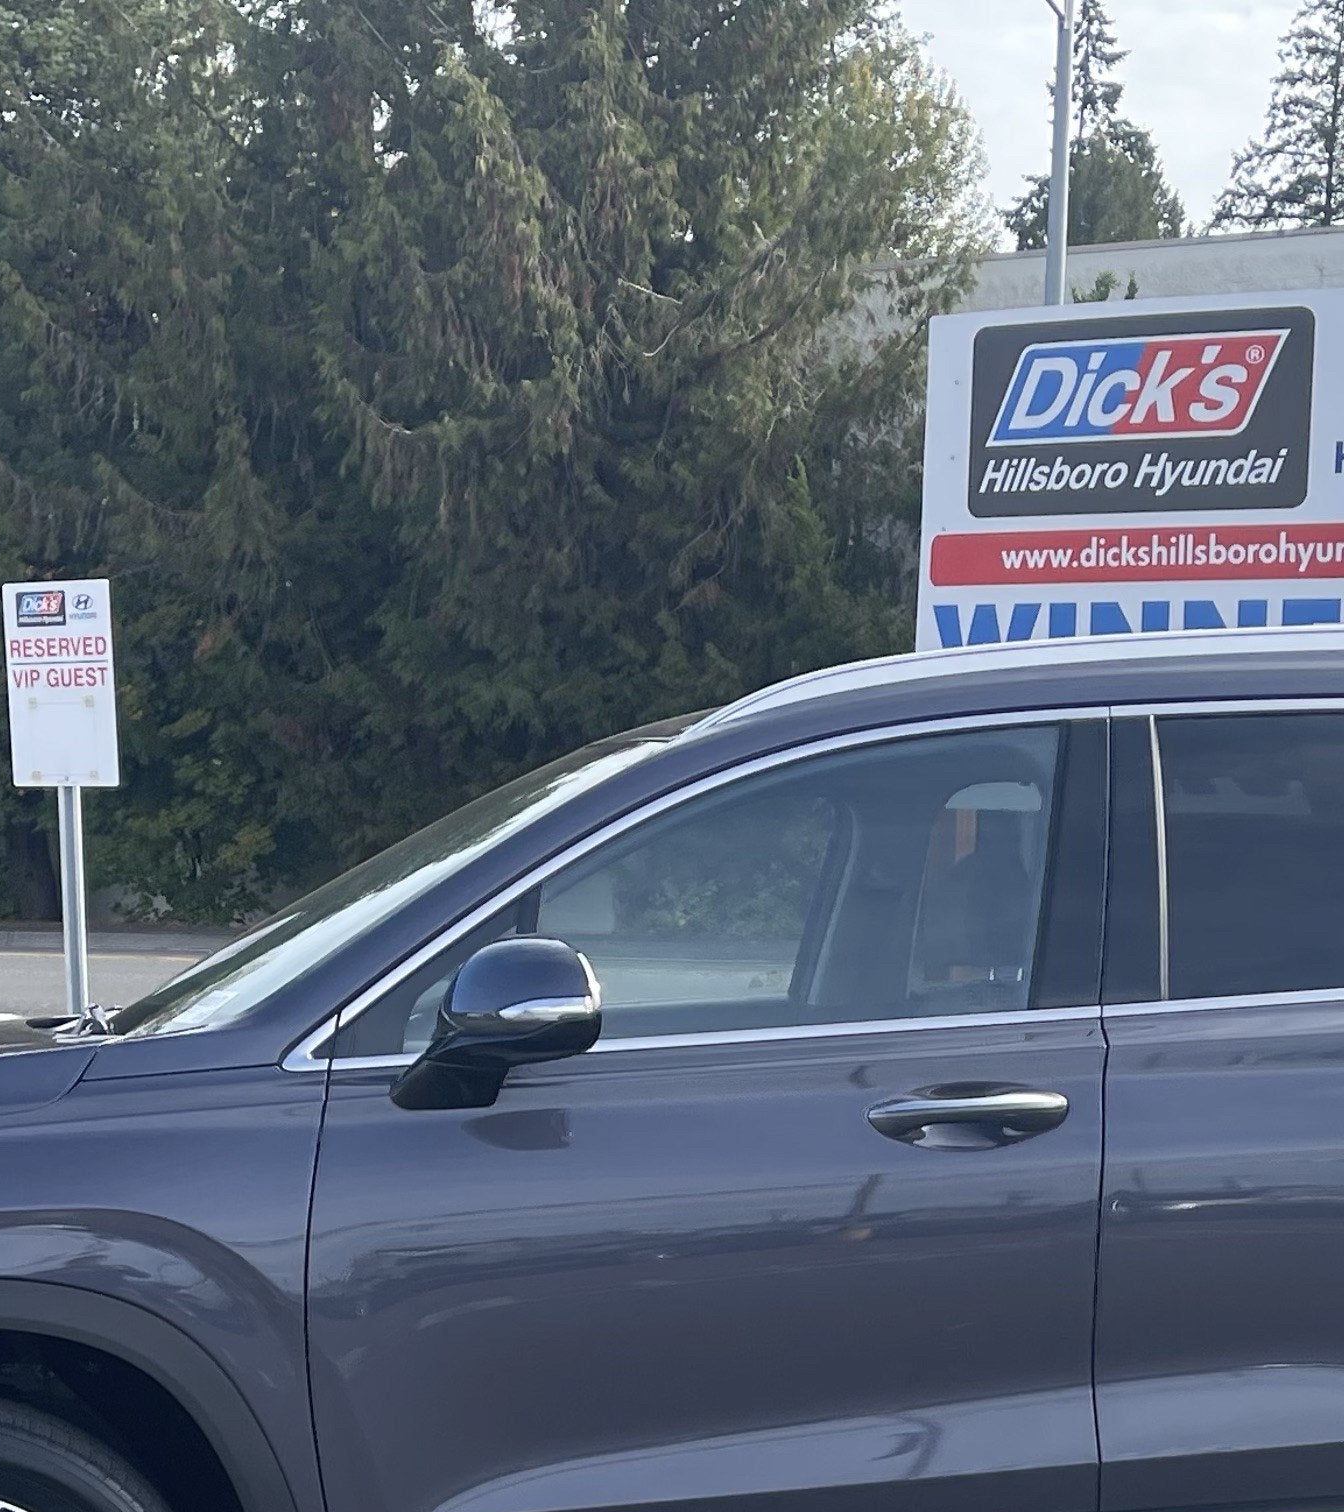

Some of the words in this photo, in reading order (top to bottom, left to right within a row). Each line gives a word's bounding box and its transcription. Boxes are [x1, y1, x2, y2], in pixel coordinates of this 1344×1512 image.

[979, 456, 1129, 493] Hillsboro
[1133, 448, 1288, 496] Hyundai
[9, 636, 107, 659] RESERVED
[12, 669, 40, 688] VIP
[46, 667, 108, 687] GUEST
